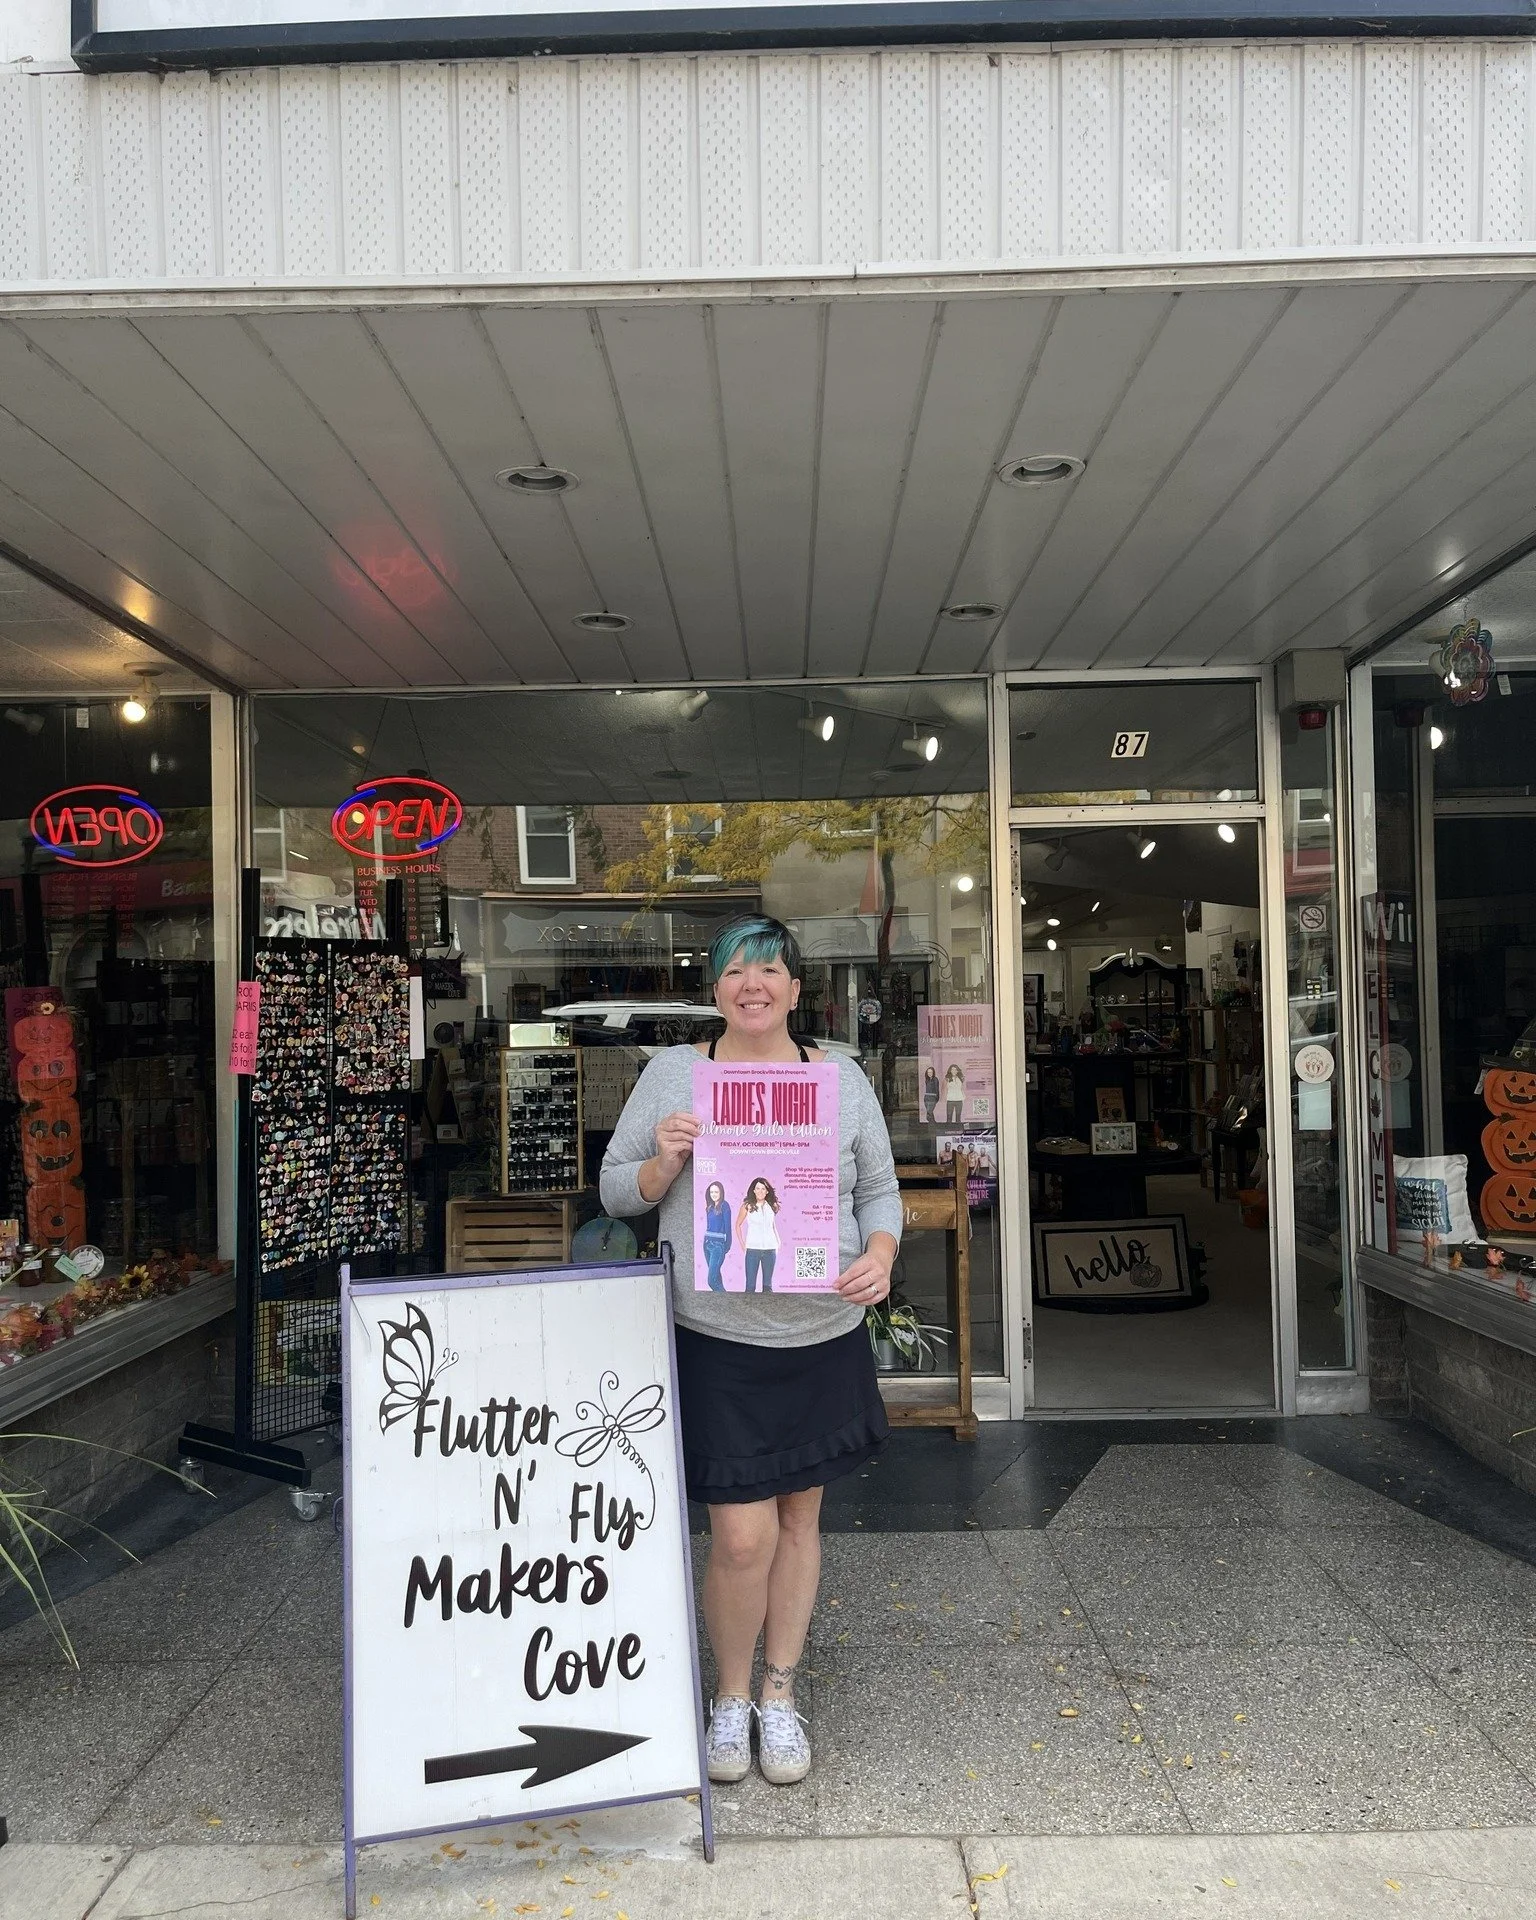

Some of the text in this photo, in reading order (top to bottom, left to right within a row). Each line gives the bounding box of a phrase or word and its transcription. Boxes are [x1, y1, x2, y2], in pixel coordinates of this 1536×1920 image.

[1115, 734, 1146, 756] 87
[340, 798, 449, 839] OPEN
[357, 864, 441, 876] BUSINESS HOURS
[359, 898, 378, 906] WED
[928, 1015, 983, 1038] LADIES NIGHT
[1364, 930, 1385, 1204] WELCME
[713, 1082, 818, 1126] LADIES NIGHT
[697, 1120, 835, 1137] Gilmore Girls Edition
[696, 1160, 717, 1168] BROCK
[1403, 1180, 1440, 1192] what
[1064, 1235, 1150, 1288] hello
[413, 1396, 559, 1458] Flutter
[568, 1481, 640, 1551] Fly
[404, 1543, 609, 1629] Makers
[524, 1625, 646, 1701] Cove
